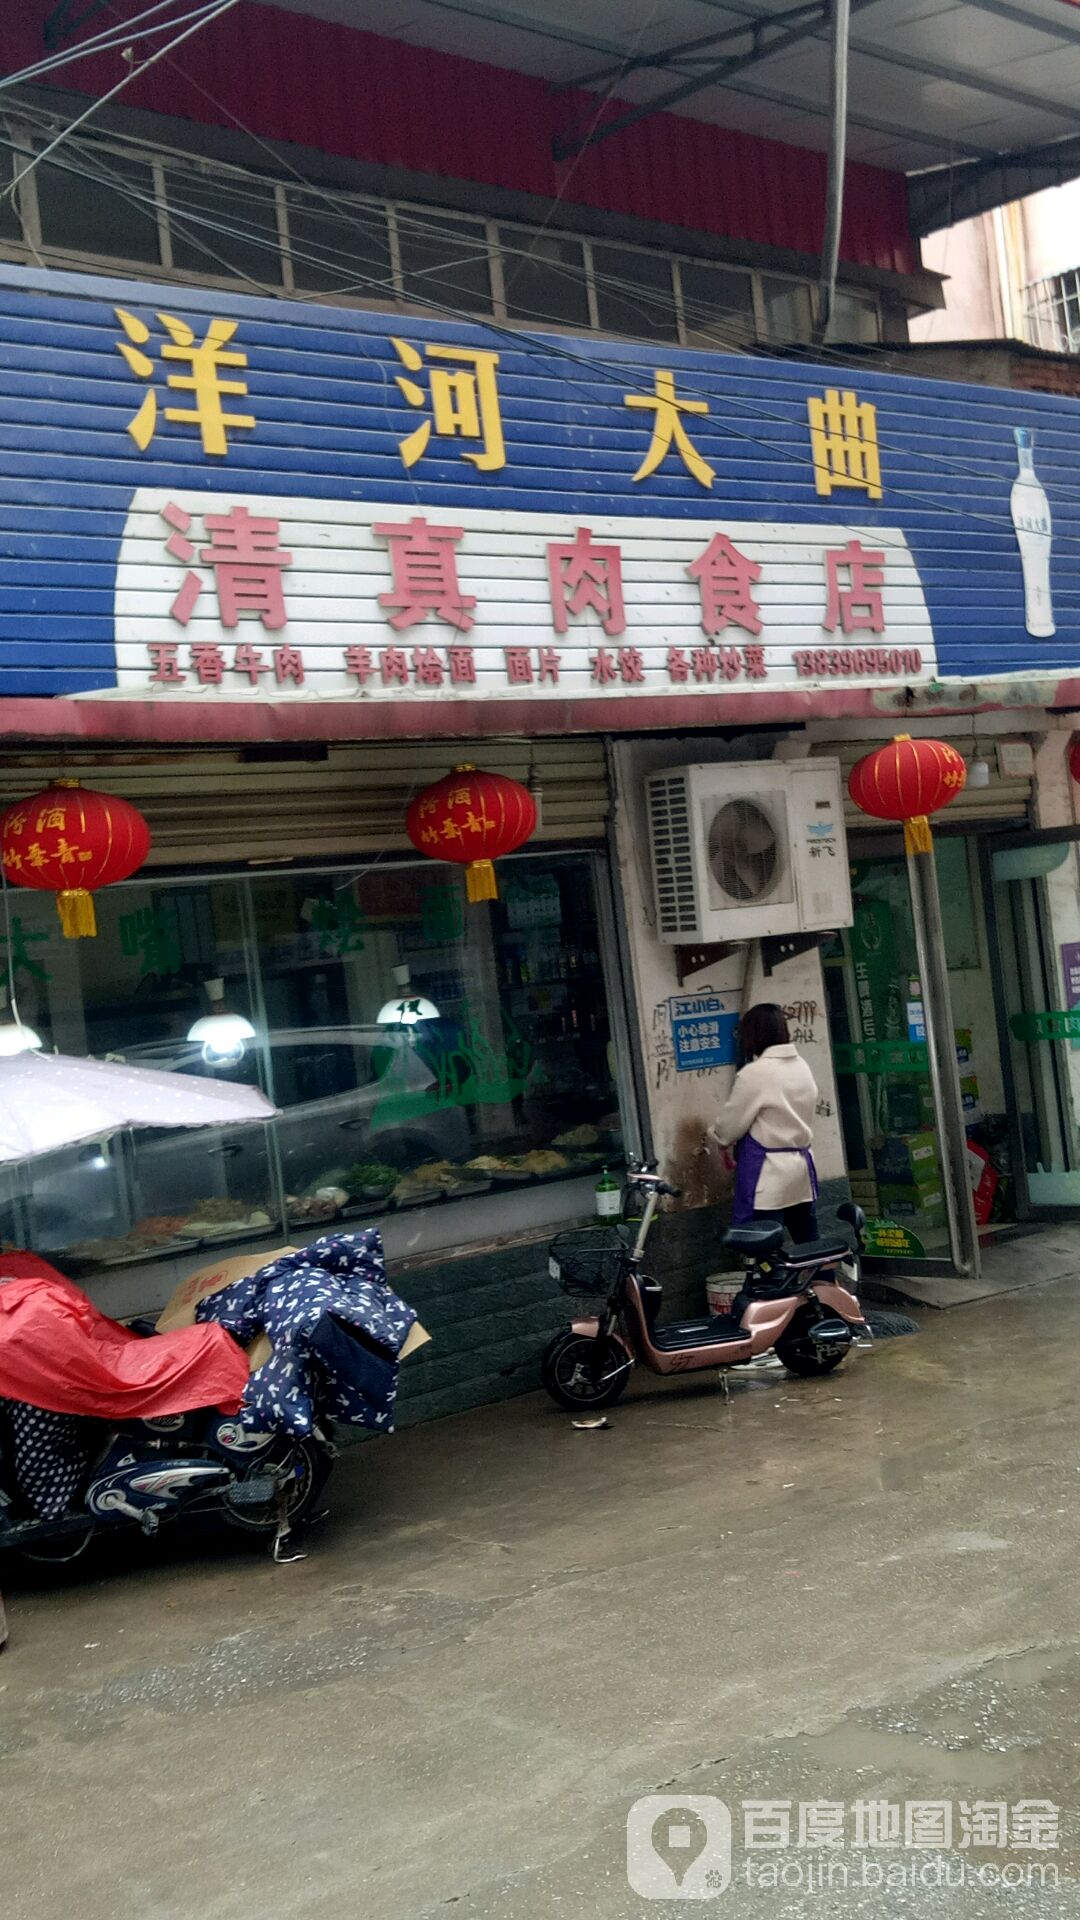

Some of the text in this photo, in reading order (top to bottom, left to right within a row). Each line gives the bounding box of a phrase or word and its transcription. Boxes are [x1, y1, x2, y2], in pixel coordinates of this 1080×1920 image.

[115, 307, 883, 500] 洋河大曲
[159, 501, 886, 637] 清真肉食店
[147, 643, 305, 685] 五香牛肉
[343, 644, 477, 685] 羊肉烩面
[504, 646, 561, 684] 面片
[590, 646, 646, 684] 水饺
[667, 644, 768, 682] 各种炒菜
